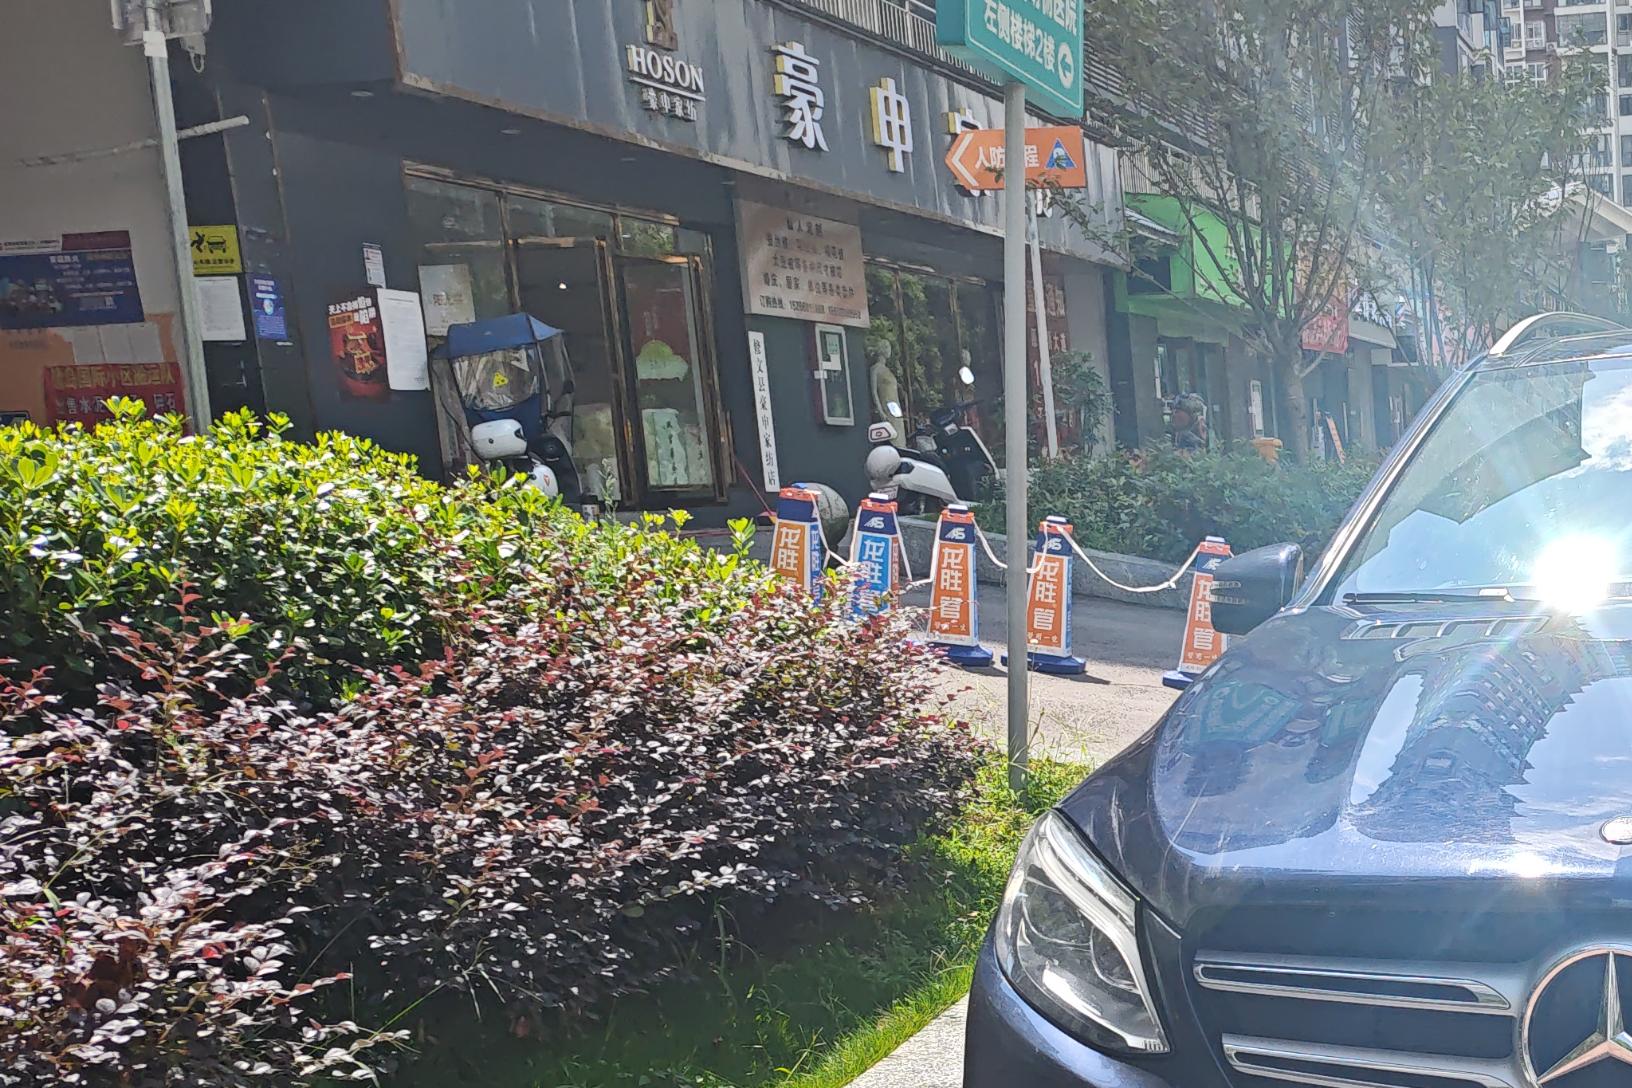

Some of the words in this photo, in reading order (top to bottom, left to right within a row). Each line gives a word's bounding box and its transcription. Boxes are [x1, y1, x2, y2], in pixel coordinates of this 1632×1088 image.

[984, 0, 1055, 73] 左侧楼梯2楼
[626, 44, 705, 93] HOSON
[975, 144, 1041, 169] 人防程
[777, 527, 801, 584] 龙胜
